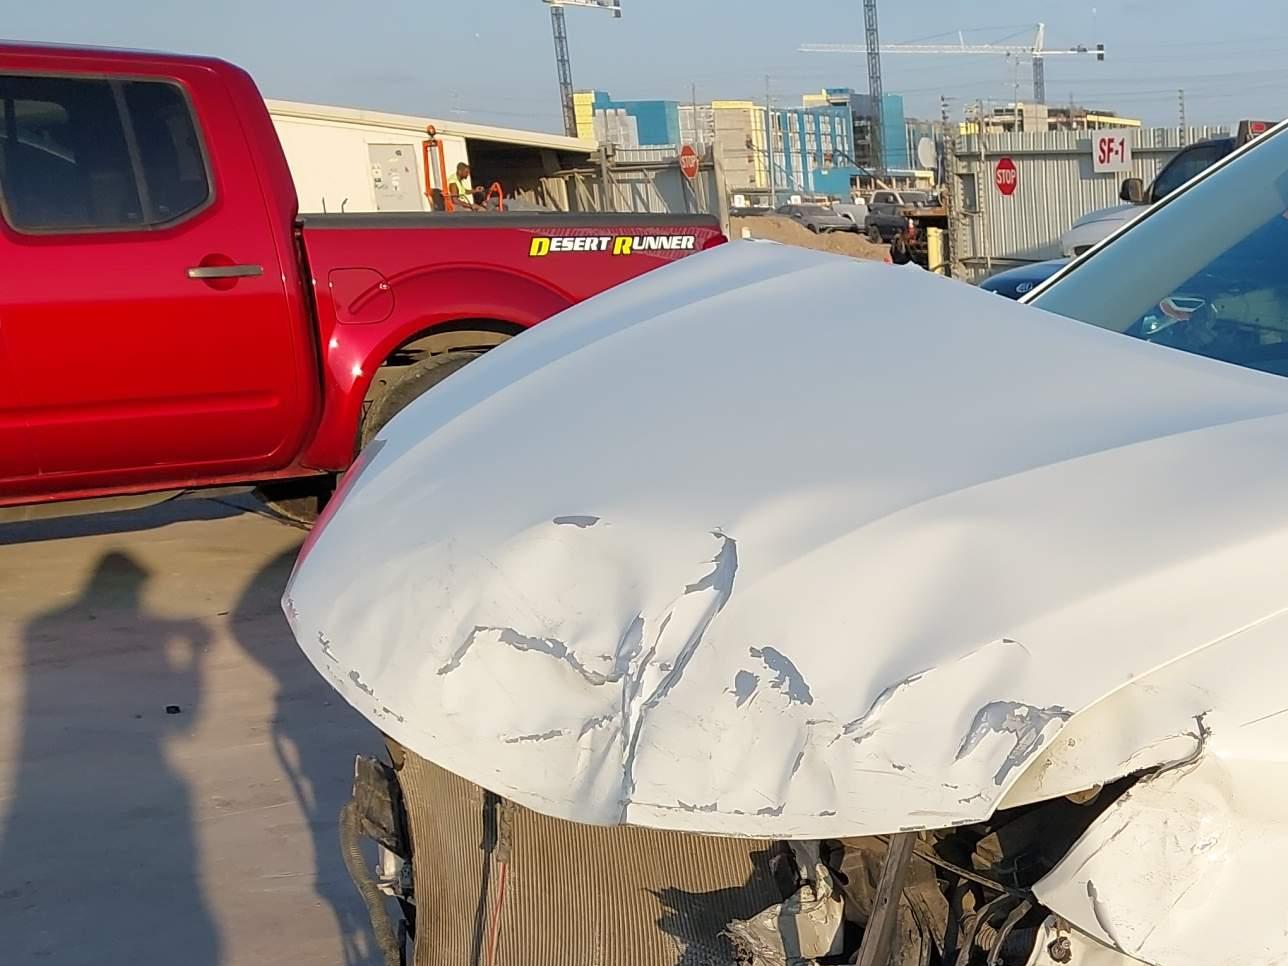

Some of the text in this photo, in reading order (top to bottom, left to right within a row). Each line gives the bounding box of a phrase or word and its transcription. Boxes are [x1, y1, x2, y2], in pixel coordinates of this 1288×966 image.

[1098, 138, 1126, 164] SF-1
[997, 169, 1016, 184] STOP
[530, 234, 695, 256] DESERT RUNNER
